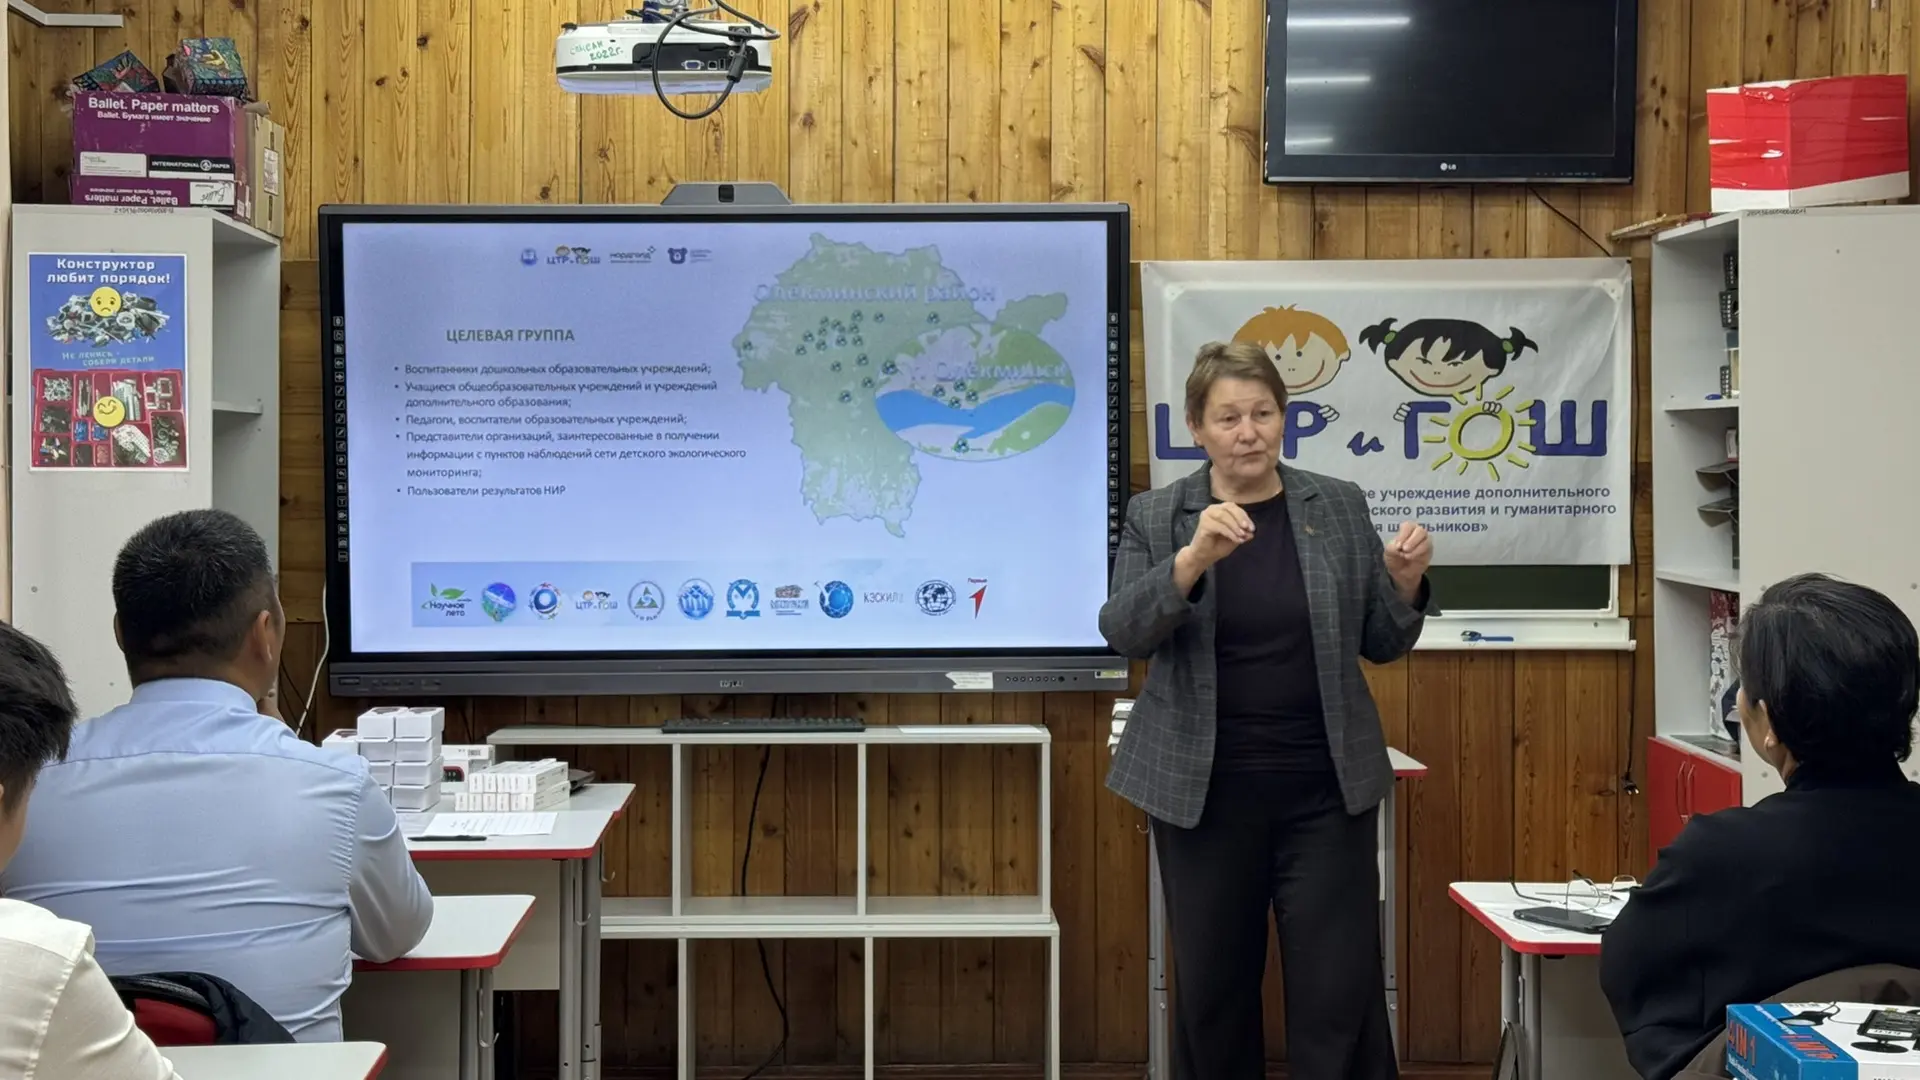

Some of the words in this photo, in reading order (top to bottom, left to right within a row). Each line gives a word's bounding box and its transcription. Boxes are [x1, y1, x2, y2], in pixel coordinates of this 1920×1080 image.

[89, 97, 128, 110] Ballet.
[132, 99, 169, 114] Paper
[172, 102, 220, 114] matters
[98, 111, 121, 119] Ballet.
[122, 111, 150, 122] Бумага
[151, 160, 199, 168] INTERNATIONAL
[85, 194, 119, 202] matters
[121, 195, 148, 204] Paper
[150, 196, 179, 205] Ballet.
[57, 258, 155, 271] Конструктор
[46, 273, 95, 284] любит
[100, 273, 171, 285] порядок!
[447, 329, 513, 343] ЦЕЛЕВАЯ
[518, 329, 575, 342] ГРУППА
[405, 365, 478, 375] Воспитанники
[480, 366, 546, 376] дошкольных
[548, 363, 639, 376] образовательных
[640, 363, 711, 375] учреждений;
[405, 382, 456, 393] Учащиеся
[458, 381, 576, 393] общеобразовательных
[578, 381, 642, 393] учреждений
[653, 381, 717, 393] учреждений
[405, 399, 496, 409] дополнительного
[497, 397, 571, 408] образования;
[406, 415, 456, 425] Педагоги,
[458, 417, 522, 425] воспитатели
[525, 414, 614, 426] образовательных
[617, 414, 687, 426] учреждений;
[406, 432, 483, 443] Представители
[486, 431, 554, 442] организаций,
[557, 433, 653, 443] заинтересованные
[665, 433, 719, 443] получении
[1346, 431, 1385, 460] и
[407, 450, 474, 461] информации
[484, 451, 524, 461] пунктов
[528, 448, 592, 460] наблюдений
[619, 451, 666, 460] детского
[668, 451, 746, 459] экологического
[407, 469, 481, 479] мониторинга;
[408, 486, 478, 496] Пользователи
[482, 488, 542, 498] результатов
[544, 485, 566, 494] НИР
[1379, 488, 1471, 501] учреждение
[1474, 487, 1611, 500] дополнительного
[1416, 505, 1486, 518] развития
[1491, 506, 1499, 515] и
[1504, 503, 1617, 518] гуманитарного
[429, 602, 465, 611] Научное
[1736, 1023, 1748, 1061] IN
[1749, 1036, 1756, 1067] 1
